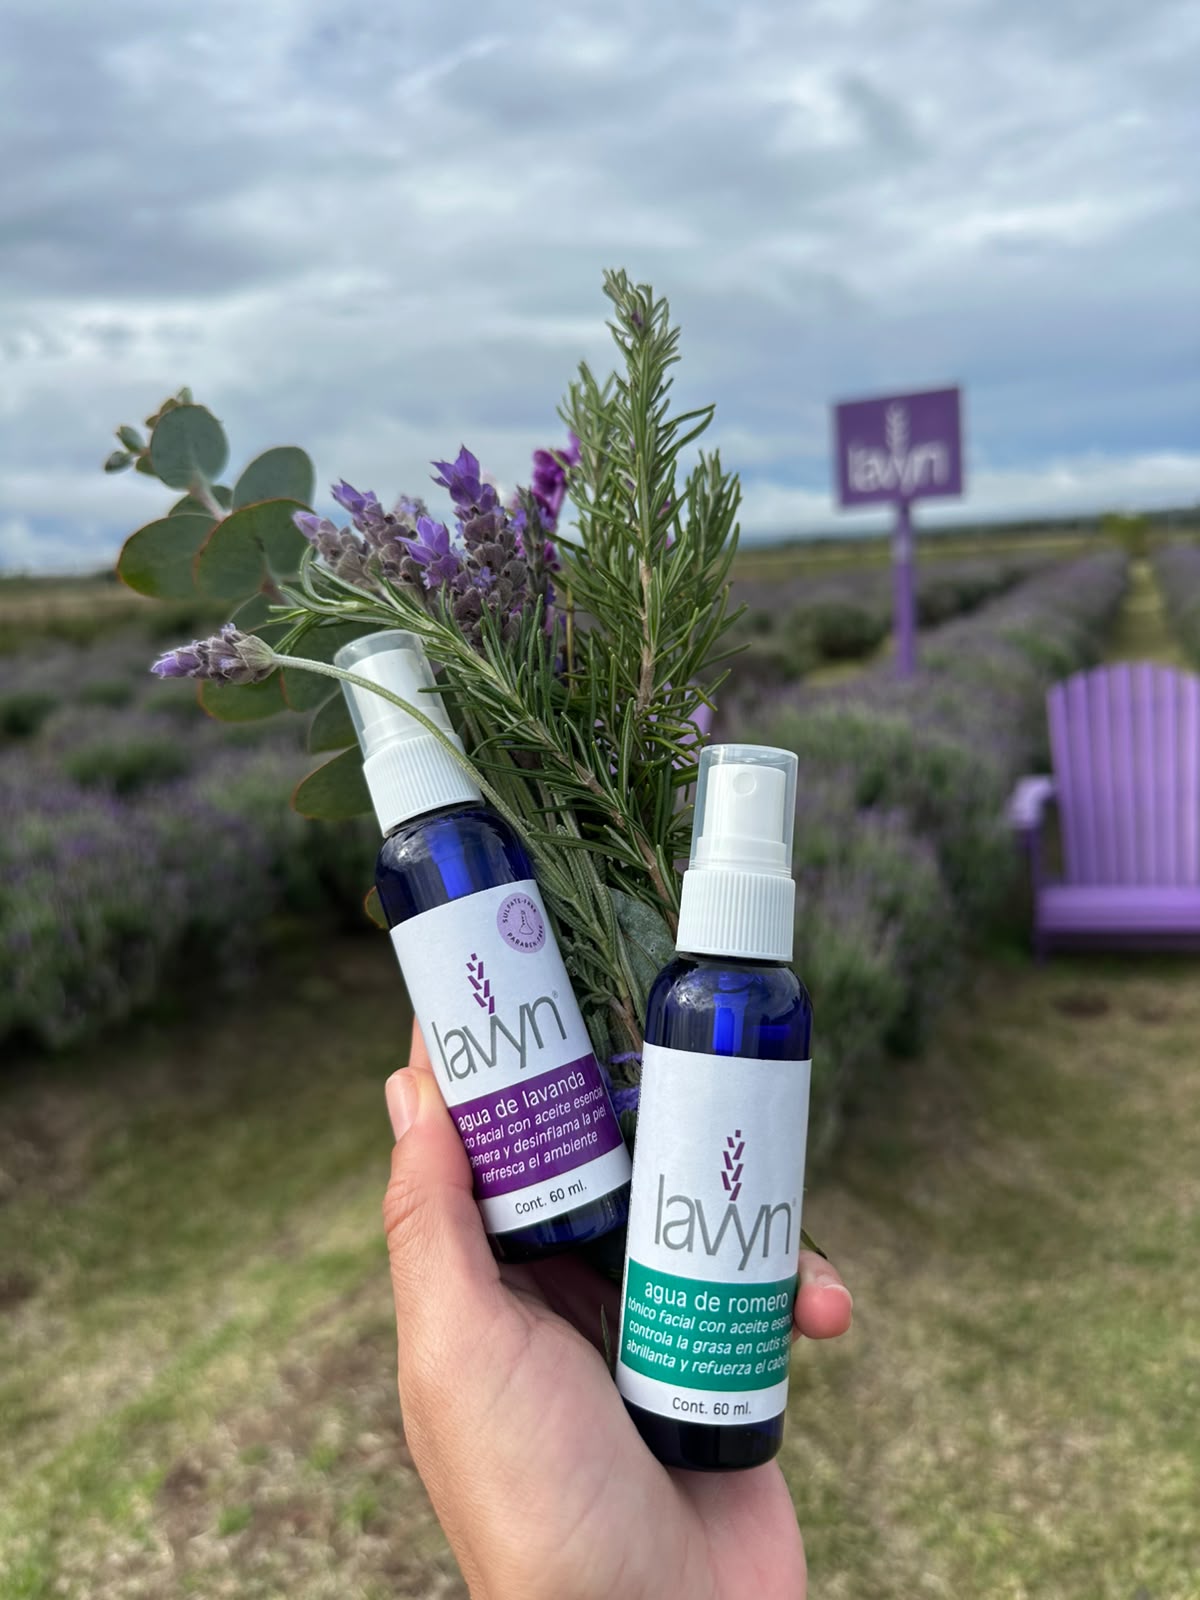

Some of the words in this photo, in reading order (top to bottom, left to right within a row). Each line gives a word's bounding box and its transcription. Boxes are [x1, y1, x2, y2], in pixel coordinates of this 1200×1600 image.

[847, 440, 950, 497] lavyn
[458, 1108, 491, 1131] agua
[495, 1098, 519, 1118] de
[522, 1071, 585, 1108] lavanda
[476, 1124, 504, 1146] facial
[507, 1117, 531, 1135] con
[534, 1101, 571, 1125] aceite
[503, 1145, 510, 1159] y
[513, 1118, 580, 1153] desinflama
[582, 1112, 591, 1126] la
[592, 1104, 607, 1123] piel
[482, 1160, 525, 1183] refresca
[528, 1152, 540, 1169] el
[543, 1130, 598, 1163] ambiente
[515, 1195, 547, 1215] Cont.
[549, 1188, 566, 1203] 60
[567, 1179, 588, 1196] ml.
[628, 1296, 657, 1321] tónico
[658, 1309, 696, 1330] facial
[698, 1320, 727, 1333] con
[729, 1319, 770, 1335] aceite
[644, 1281, 687, 1308] agua
[694, 1290, 721, 1313] de
[728, 1292, 789, 1314] romero
[629, 1319, 673, 1347] controla
[676, 1334, 689, 1350] la
[692, 1340, 732, 1354] grasa
[735, 1342, 753, 1355] en
[756, 1336, 781, 1354] cutis
[626, 1339, 676, 1368] abrillanta
[680, 1359, 690, 1373] y
[692, 1360, 752, 1376] refuerza
[755, 1359, 766, 1374] el
[672, 1396, 708, 1415] Cont.
[713, 1402, 730, 1416] 60
[733, 1401, 752, 1416] ml.
